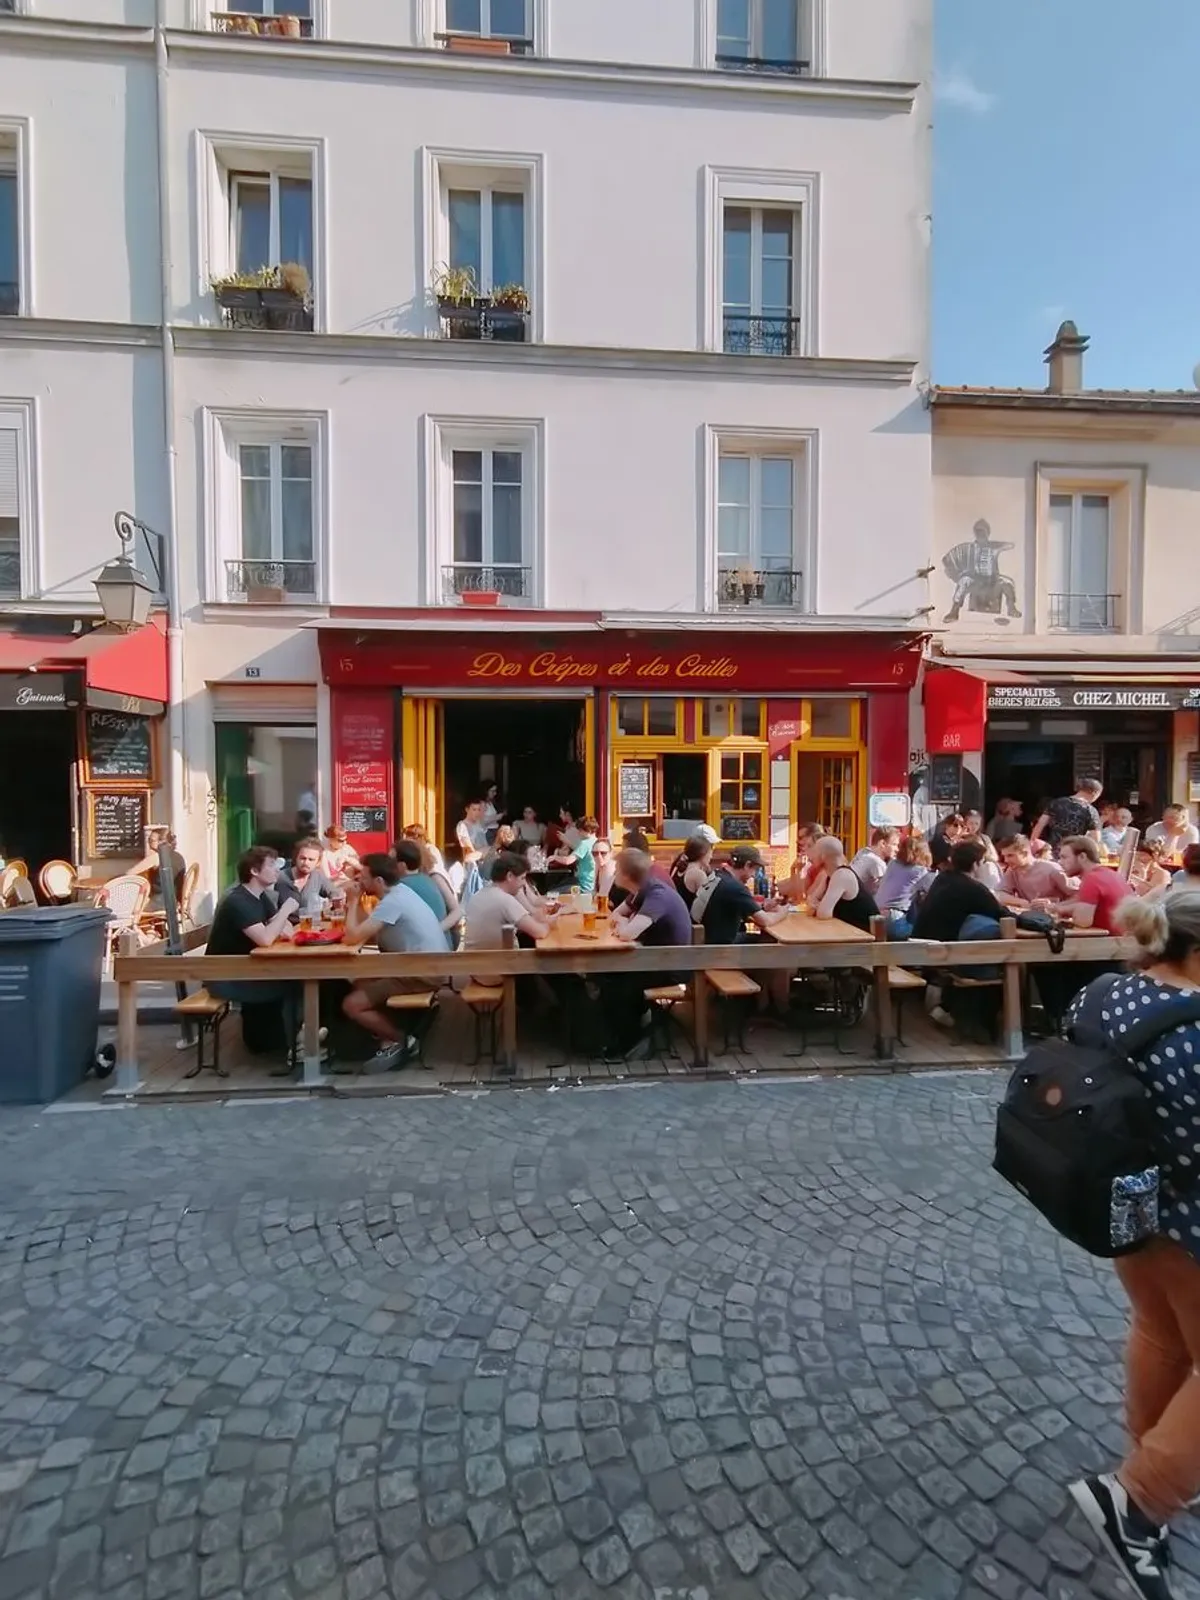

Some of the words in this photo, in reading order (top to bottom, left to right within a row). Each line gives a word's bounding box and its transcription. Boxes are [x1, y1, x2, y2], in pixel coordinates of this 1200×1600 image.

[247, 667, 259, 677] 13
[467, 651, 521, 677] Des
[528, 651, 599, 682] Crêpes
[636, 655, 670, 677] des
[675, 653, 739, 678] Cailles
[994, 687, 1056, 697] SPECIALITES
[988, 697, 1023, 707] BIERES
[1024, 697, 1062, 707] BELGES
[1073, 691, 1112, 706] CHEZ
[1116, 692, 1170, 706] MICHEL
[943, 733, 961, 748] BAR
